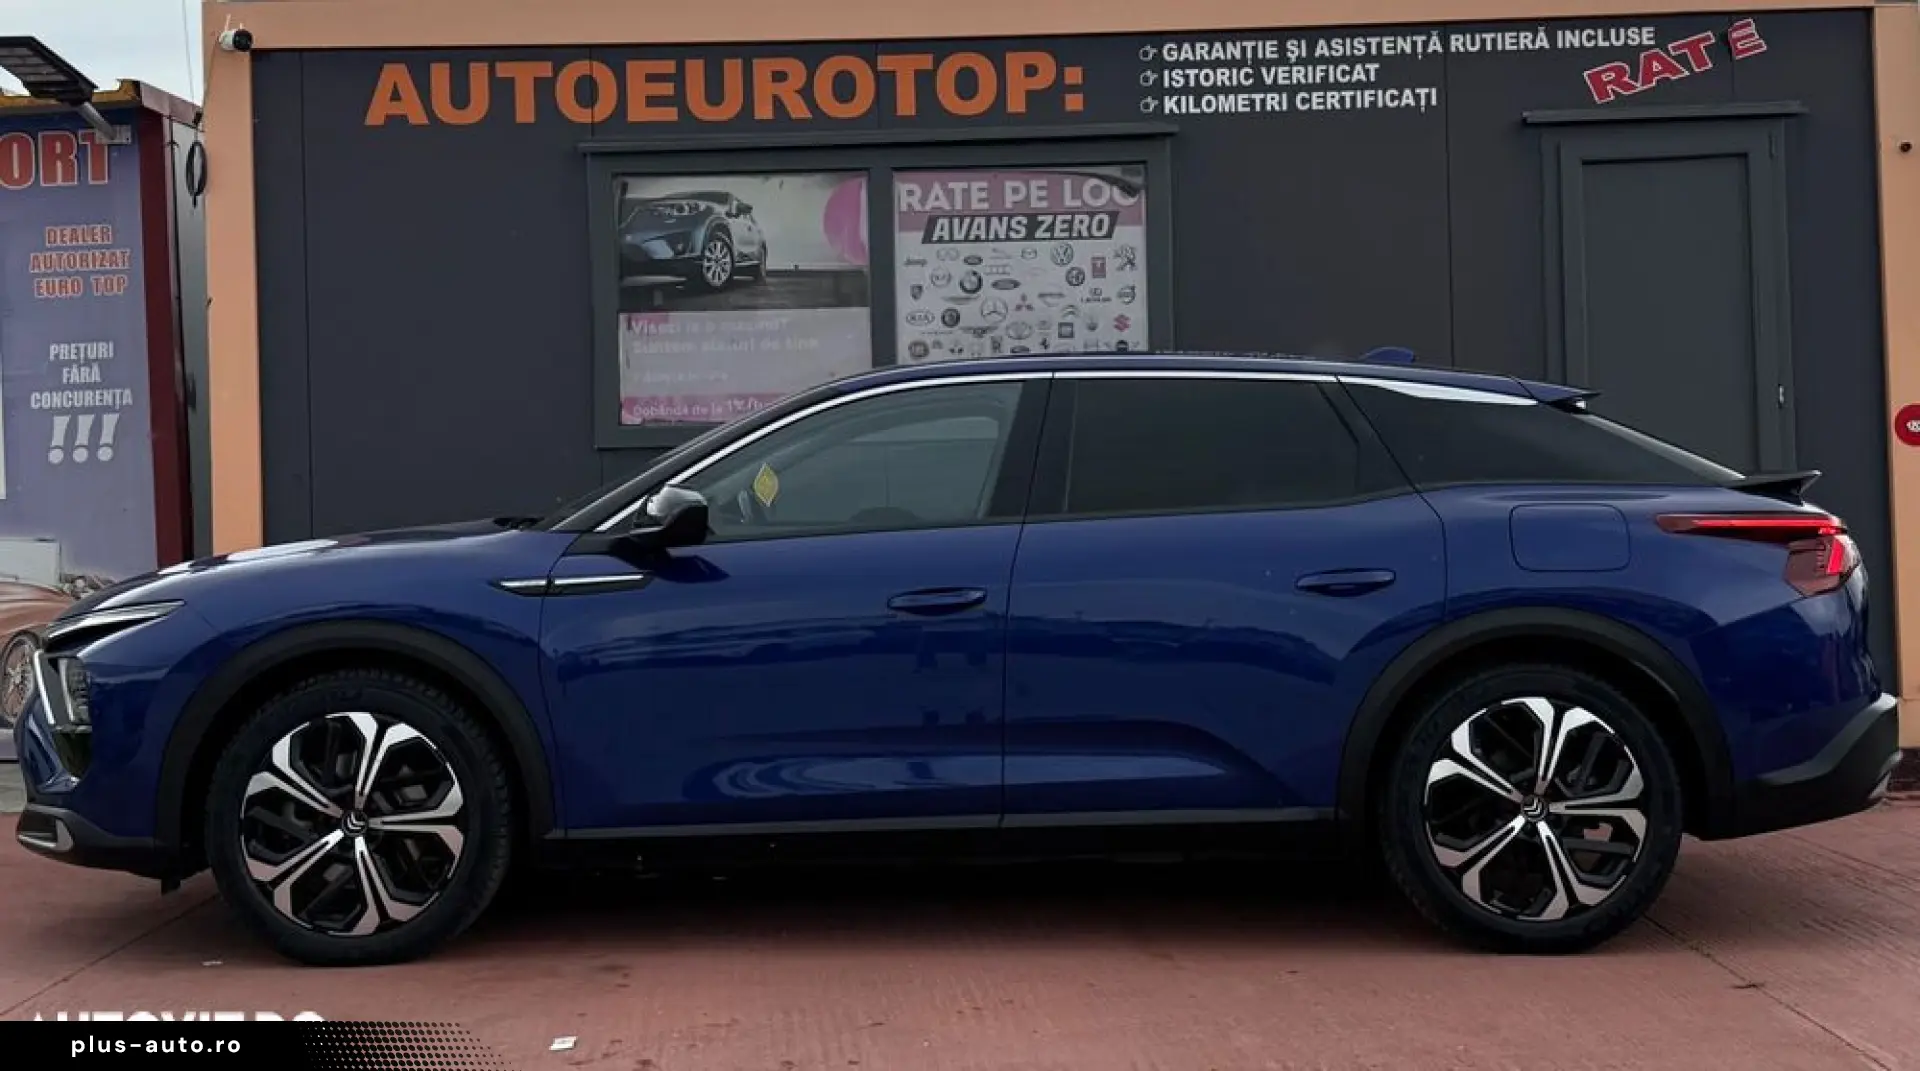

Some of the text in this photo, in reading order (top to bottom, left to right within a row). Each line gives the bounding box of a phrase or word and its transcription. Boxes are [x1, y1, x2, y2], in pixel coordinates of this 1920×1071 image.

[1450, 26, 1549, 52] RUTIERĂ
[1556, 27, 1656, 49] INCLUSE
[364, 50, 1084, 126] AUTOEUROTOP:
[1163, 63, 1380, 89] ISTORIC VERIFICAT
[1163, 92, 1288, 114] KILOMETRI
[898, 181, 989, 212] RATE
[1004, 180, 1048, 209] PE
[46, 225, 111, 247] DEALER
[931, 213, 1111, 241] AVANS ZERO
[30, 249, 131, 273] AUTORIZAT
[34, 275, 127, 298] EURO TOP
